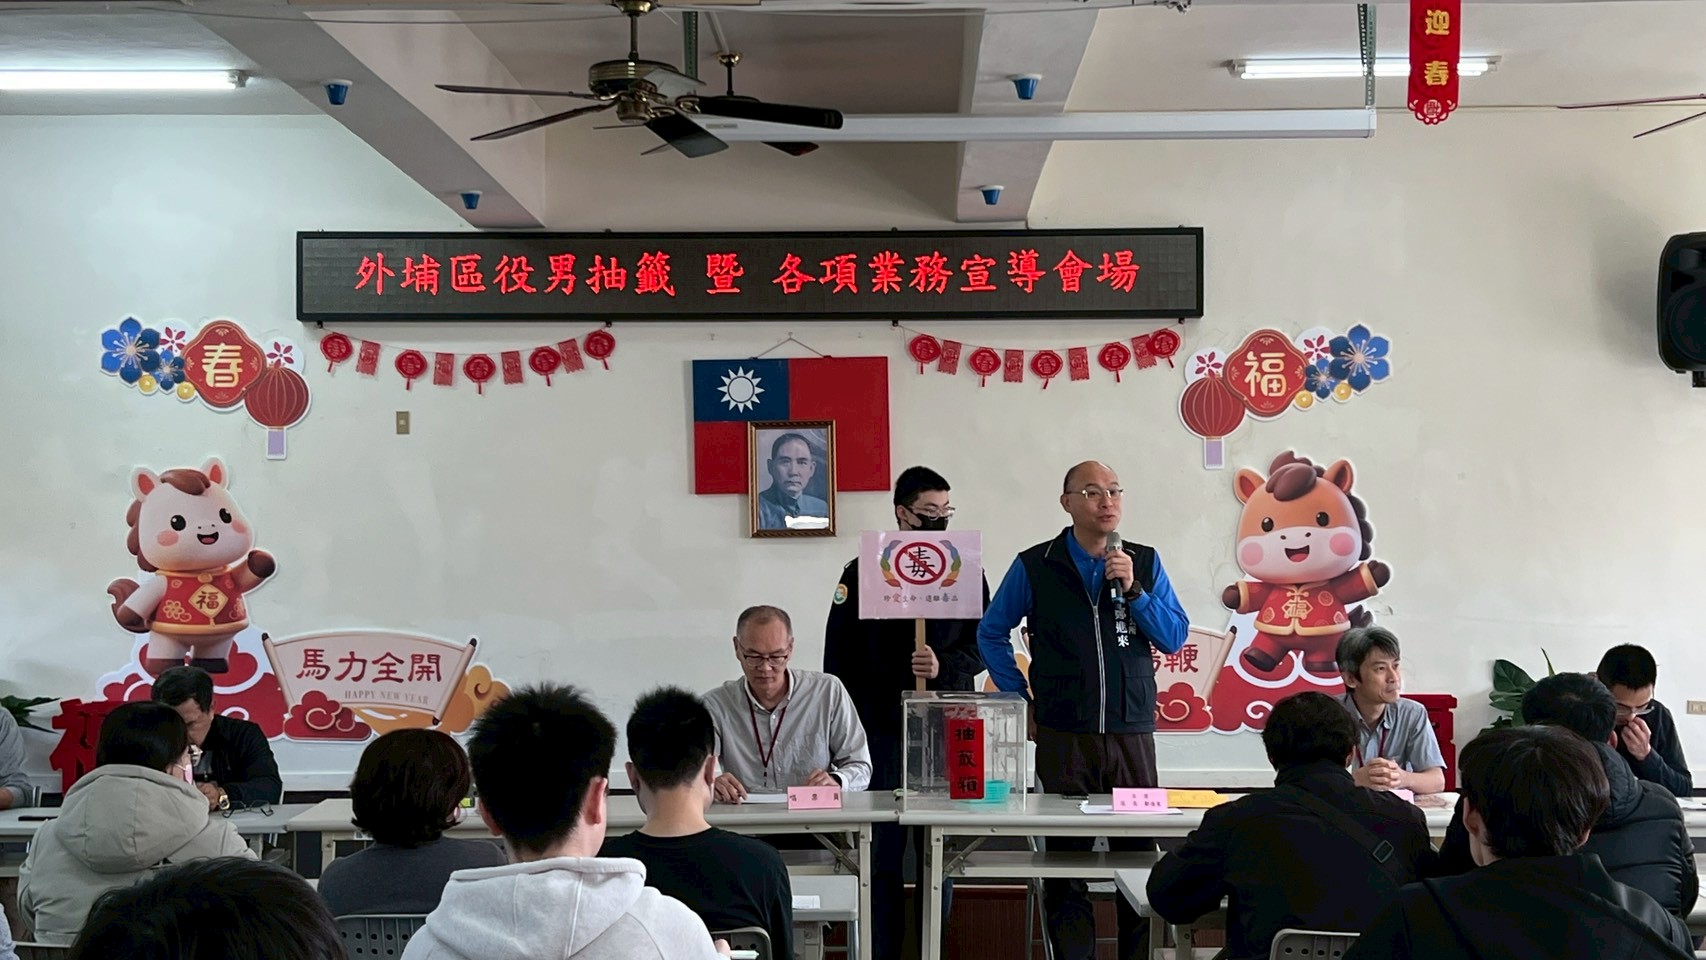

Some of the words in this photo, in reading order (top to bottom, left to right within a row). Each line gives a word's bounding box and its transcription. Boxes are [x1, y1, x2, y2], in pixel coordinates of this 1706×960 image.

[1424, 9, 1450, 86] 迎春
[354, 251, 676, 297] 外埔區役男抽籤
[705, 253, 745, 295] 暨
[772, 249, 1141, 295] 各項業務宣導會場
[201, 342, 243, 388] 春
[1244, 351, 1287, 397] 福
[905, 547, 936, 578] 毒
[196, 591, 219, 609] 福
[296, 648, 442, 683] 馬力全開
[344, 690, 375, 700] HAPPY
[380, 691, 401, 701] NEW
[404, 693, 429, 705] YEAR
